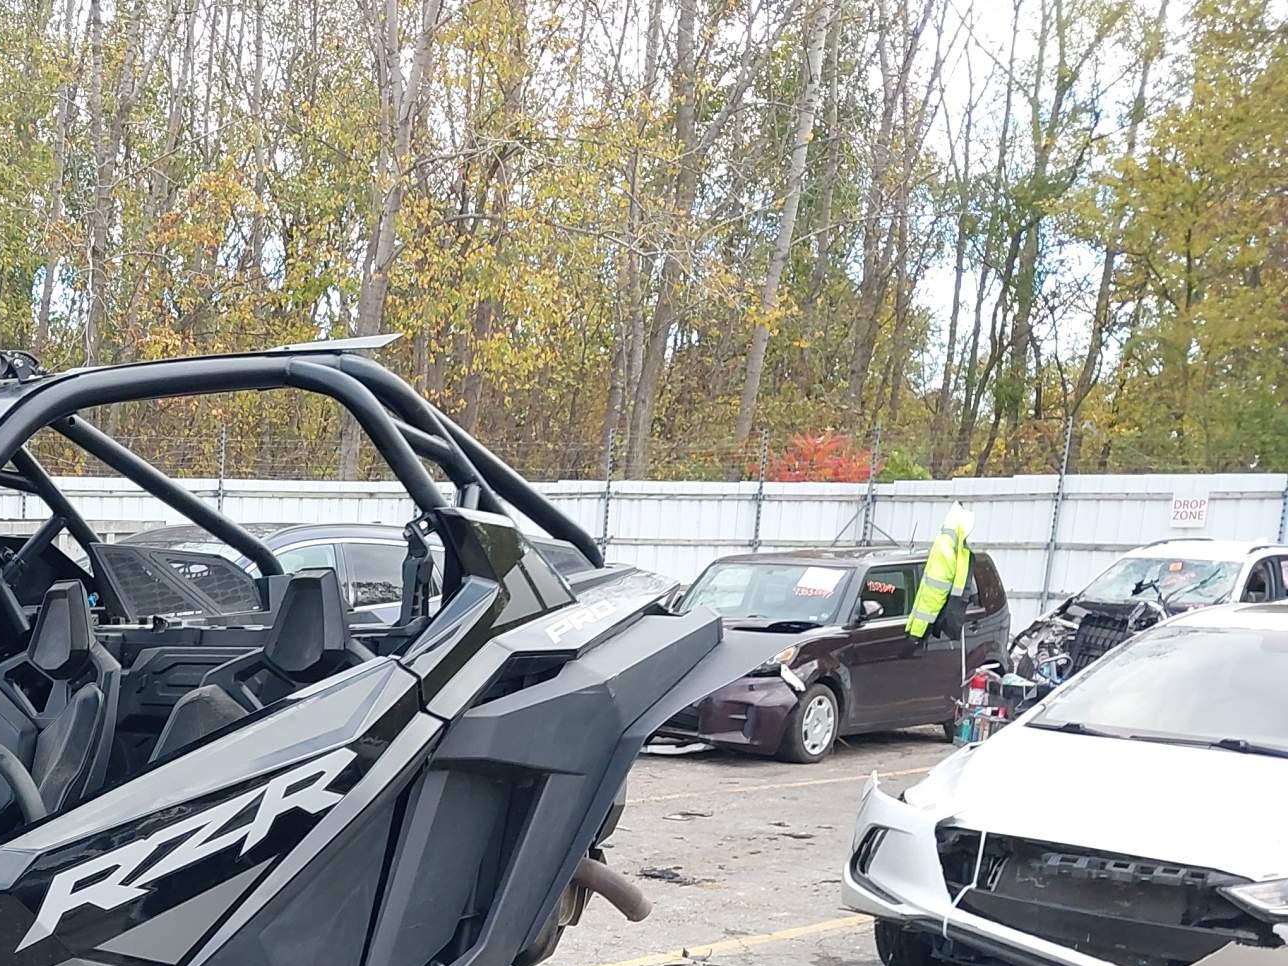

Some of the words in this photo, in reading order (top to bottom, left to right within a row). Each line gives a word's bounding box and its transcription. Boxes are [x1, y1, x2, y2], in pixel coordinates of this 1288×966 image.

[1172, 511, 1204, 521] ZONE
[1173, 500, 1206, 511] DROP
[543, 599, 616, 645] PRO
[16, 747, 358, 951] RZR
